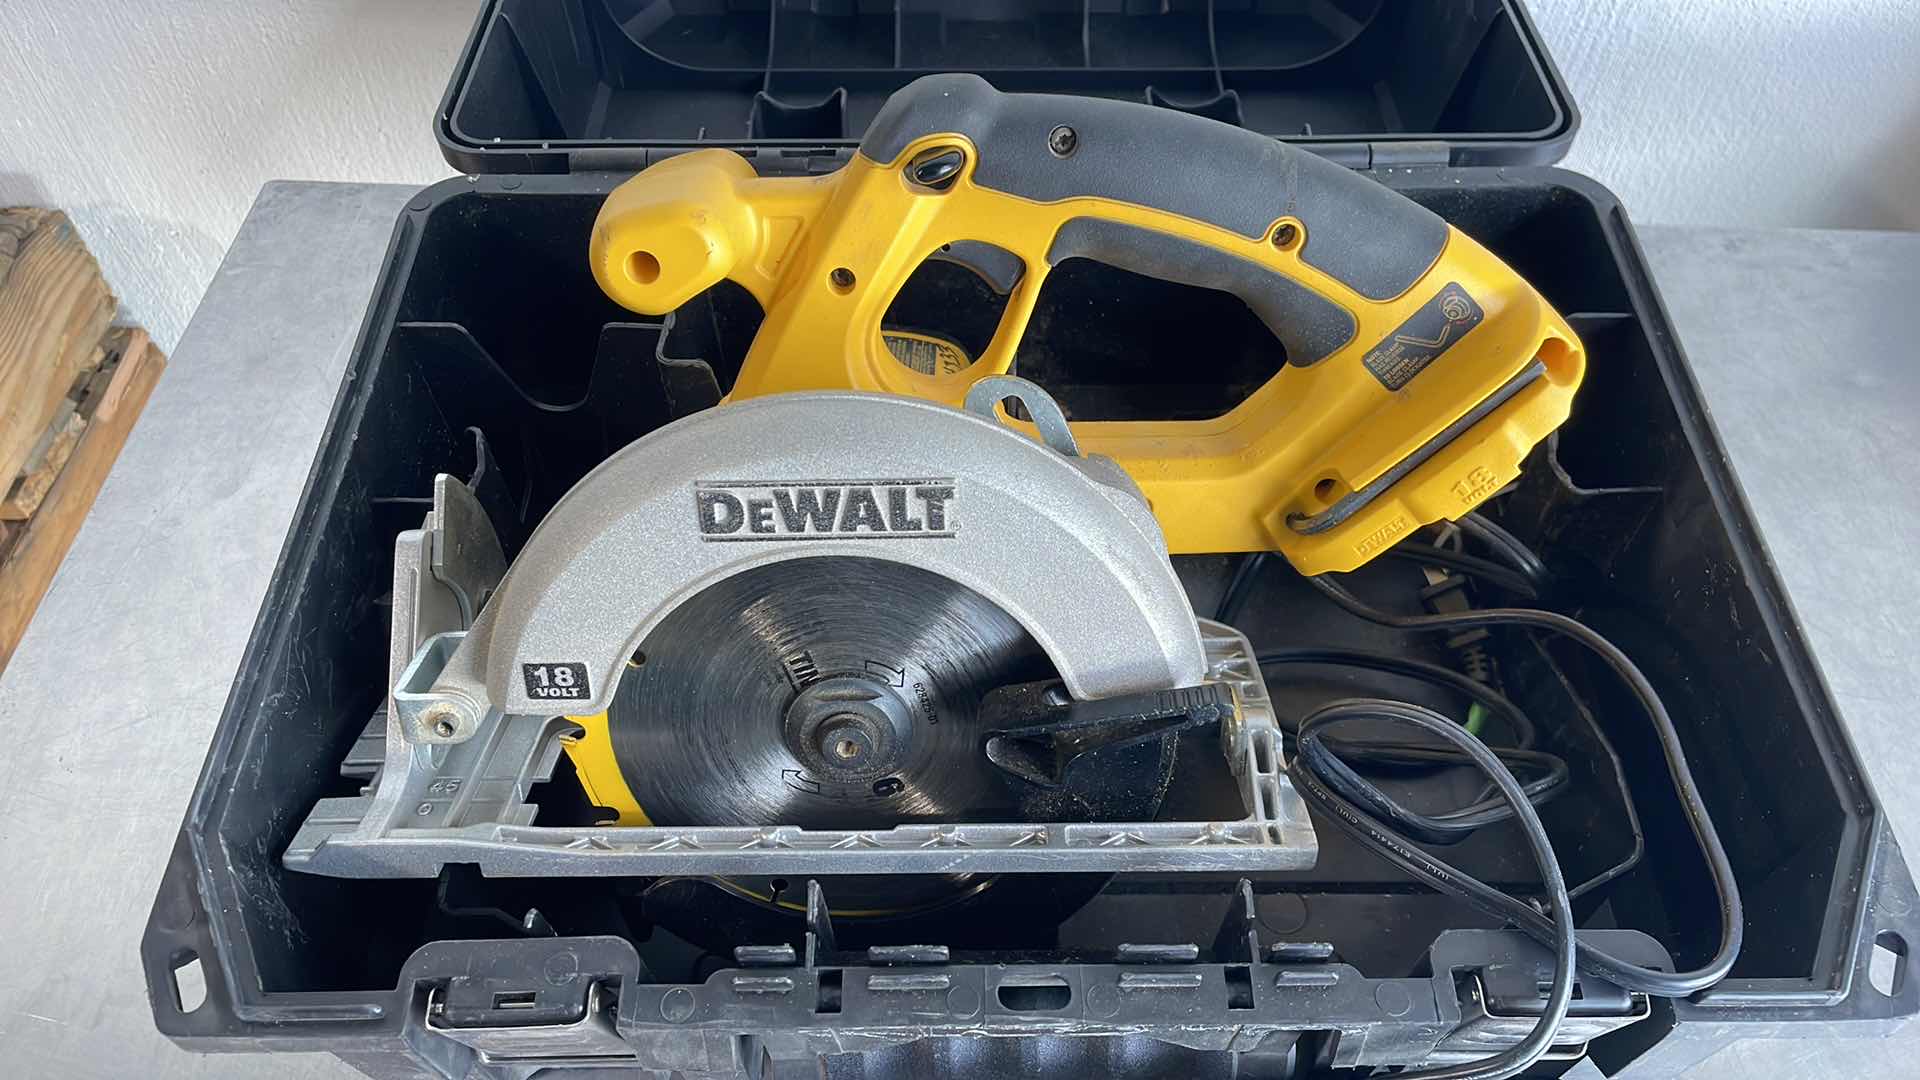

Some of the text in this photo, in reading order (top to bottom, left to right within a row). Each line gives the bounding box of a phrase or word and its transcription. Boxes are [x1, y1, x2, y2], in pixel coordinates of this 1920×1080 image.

[696, 486, 955, 535] DEWALT
[534, 666, 575, 687] 18
[535, 687, 580, 697] VOLT
[428, 778, 462, 793] 45
